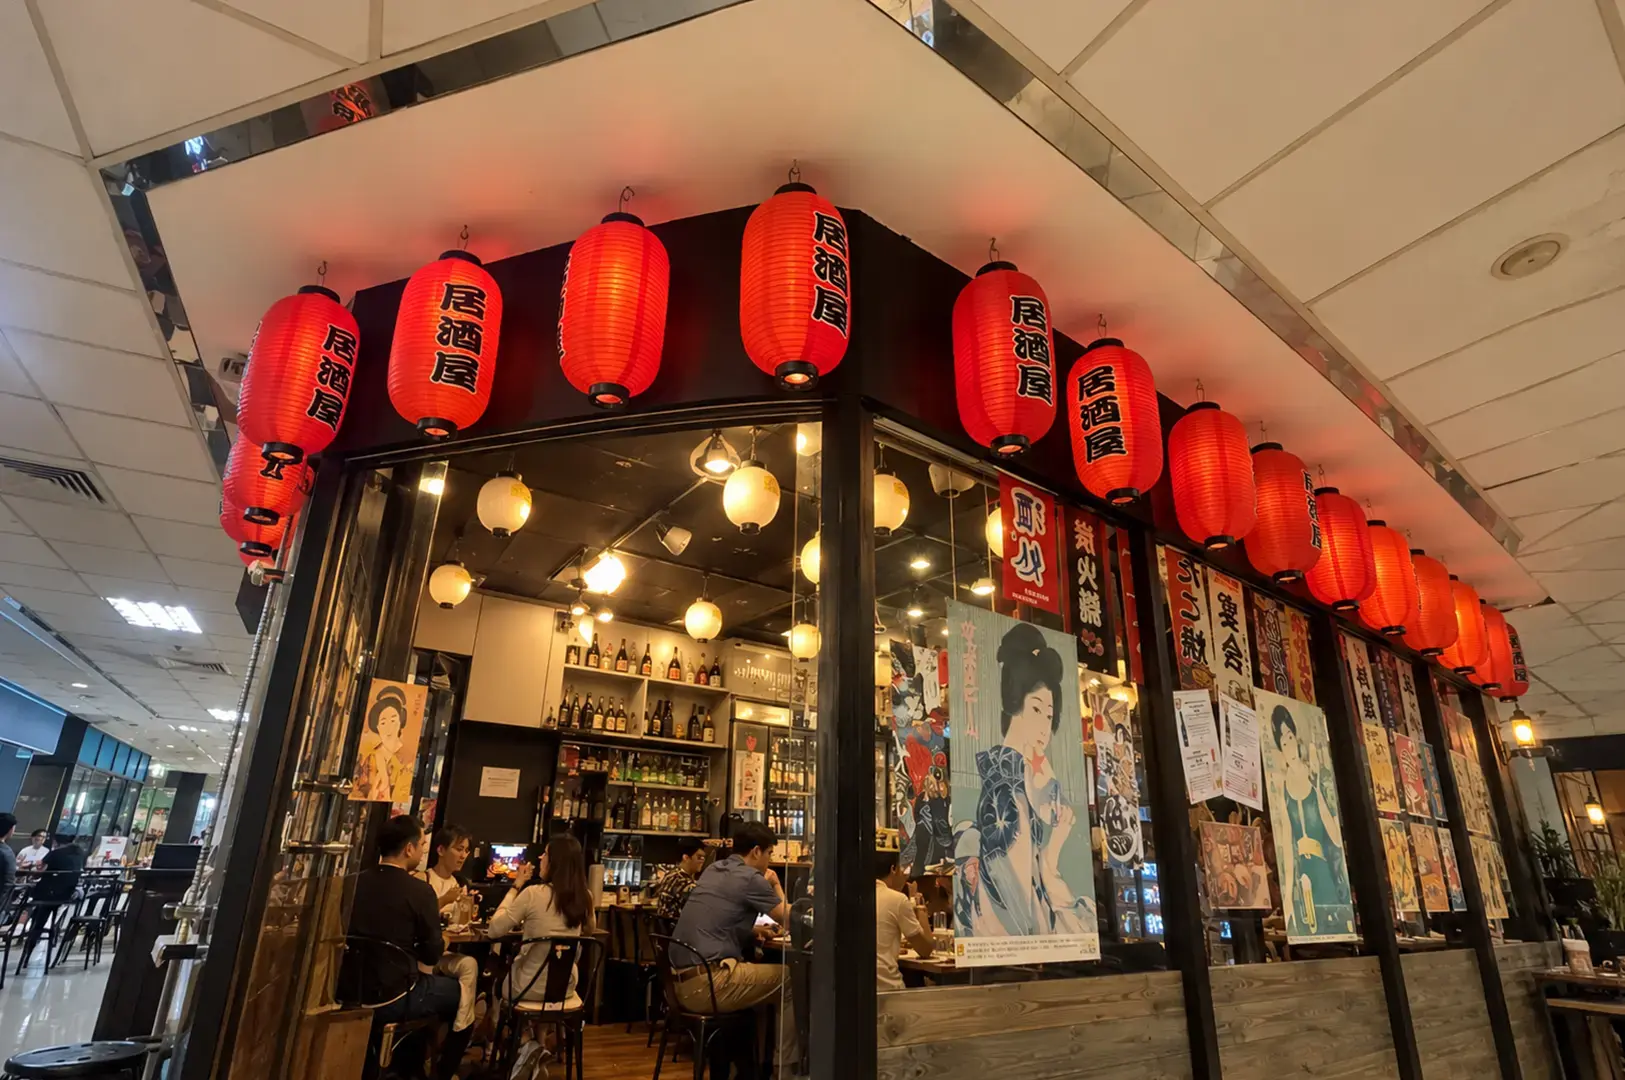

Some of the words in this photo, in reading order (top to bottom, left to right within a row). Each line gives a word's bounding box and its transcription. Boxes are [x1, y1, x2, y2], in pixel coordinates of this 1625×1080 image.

[812, 211, 848, 338] 居酒屋
[307, 324, 357, 432] 居酒屋
[430, 282, 487, 394] 居酒屋
[1010, 295, 1053, 407] 居酒屋
[1077, 365, 1129, 464] 居酒屋
